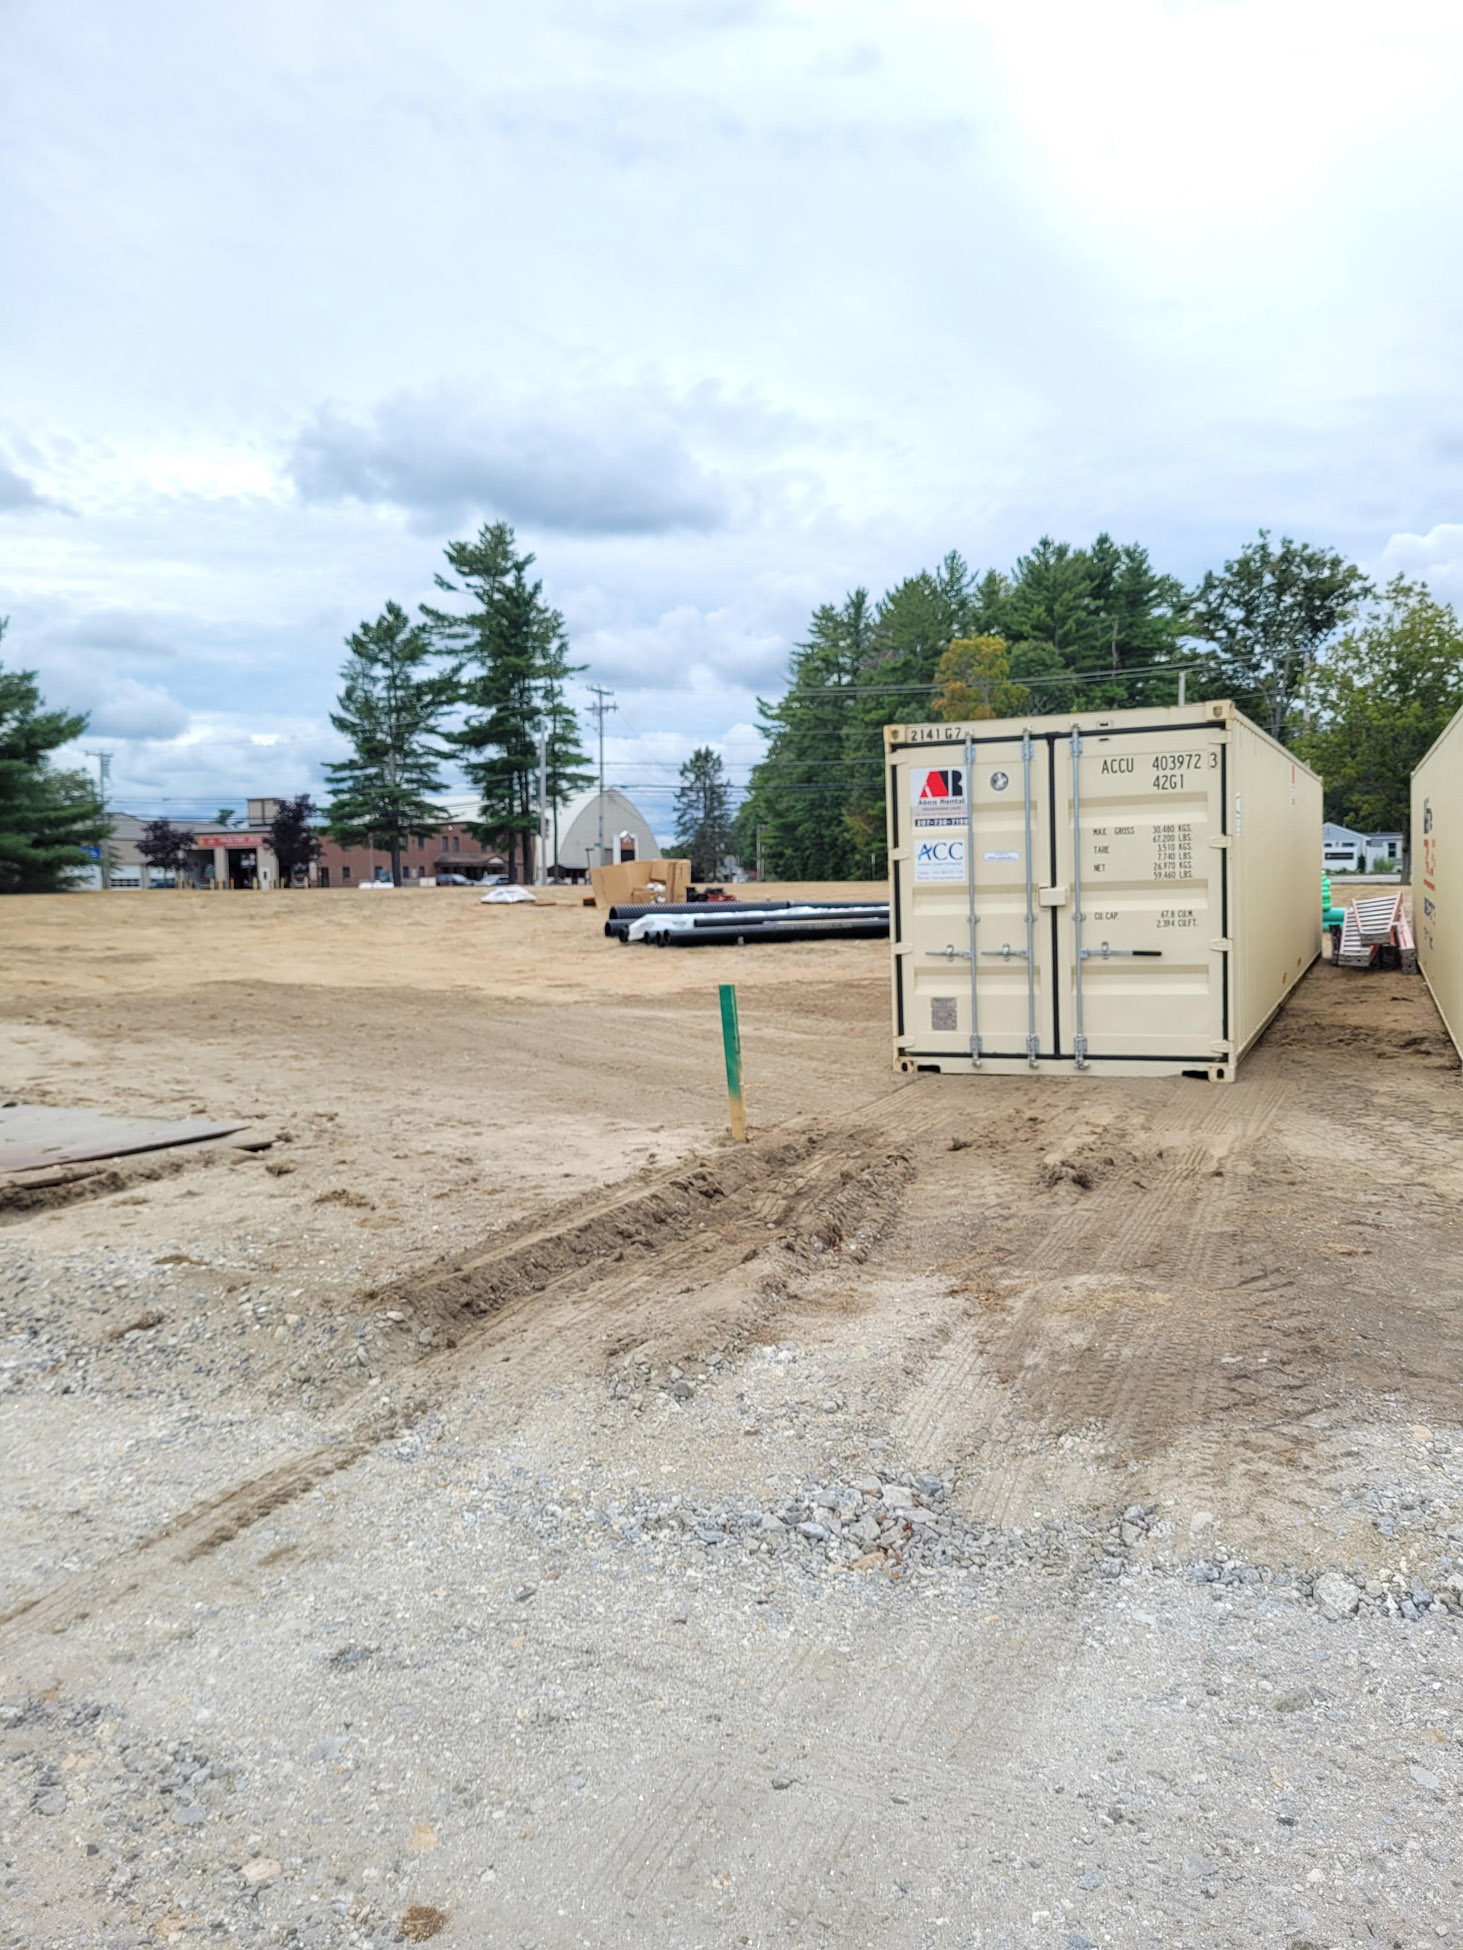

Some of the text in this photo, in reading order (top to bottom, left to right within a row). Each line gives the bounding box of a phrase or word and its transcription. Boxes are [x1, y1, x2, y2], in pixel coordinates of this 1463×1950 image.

[1101, 752, 1218, 774] ACCU 403972 3
[1152, 774, 1184, 791] 42G1
[1113, 826, 1135, 836] GROSS
[917, 841, 963, 861] ACC
[1093, 845, 1110, 854] TARE
[1093, 863, 1106, 872] NET
